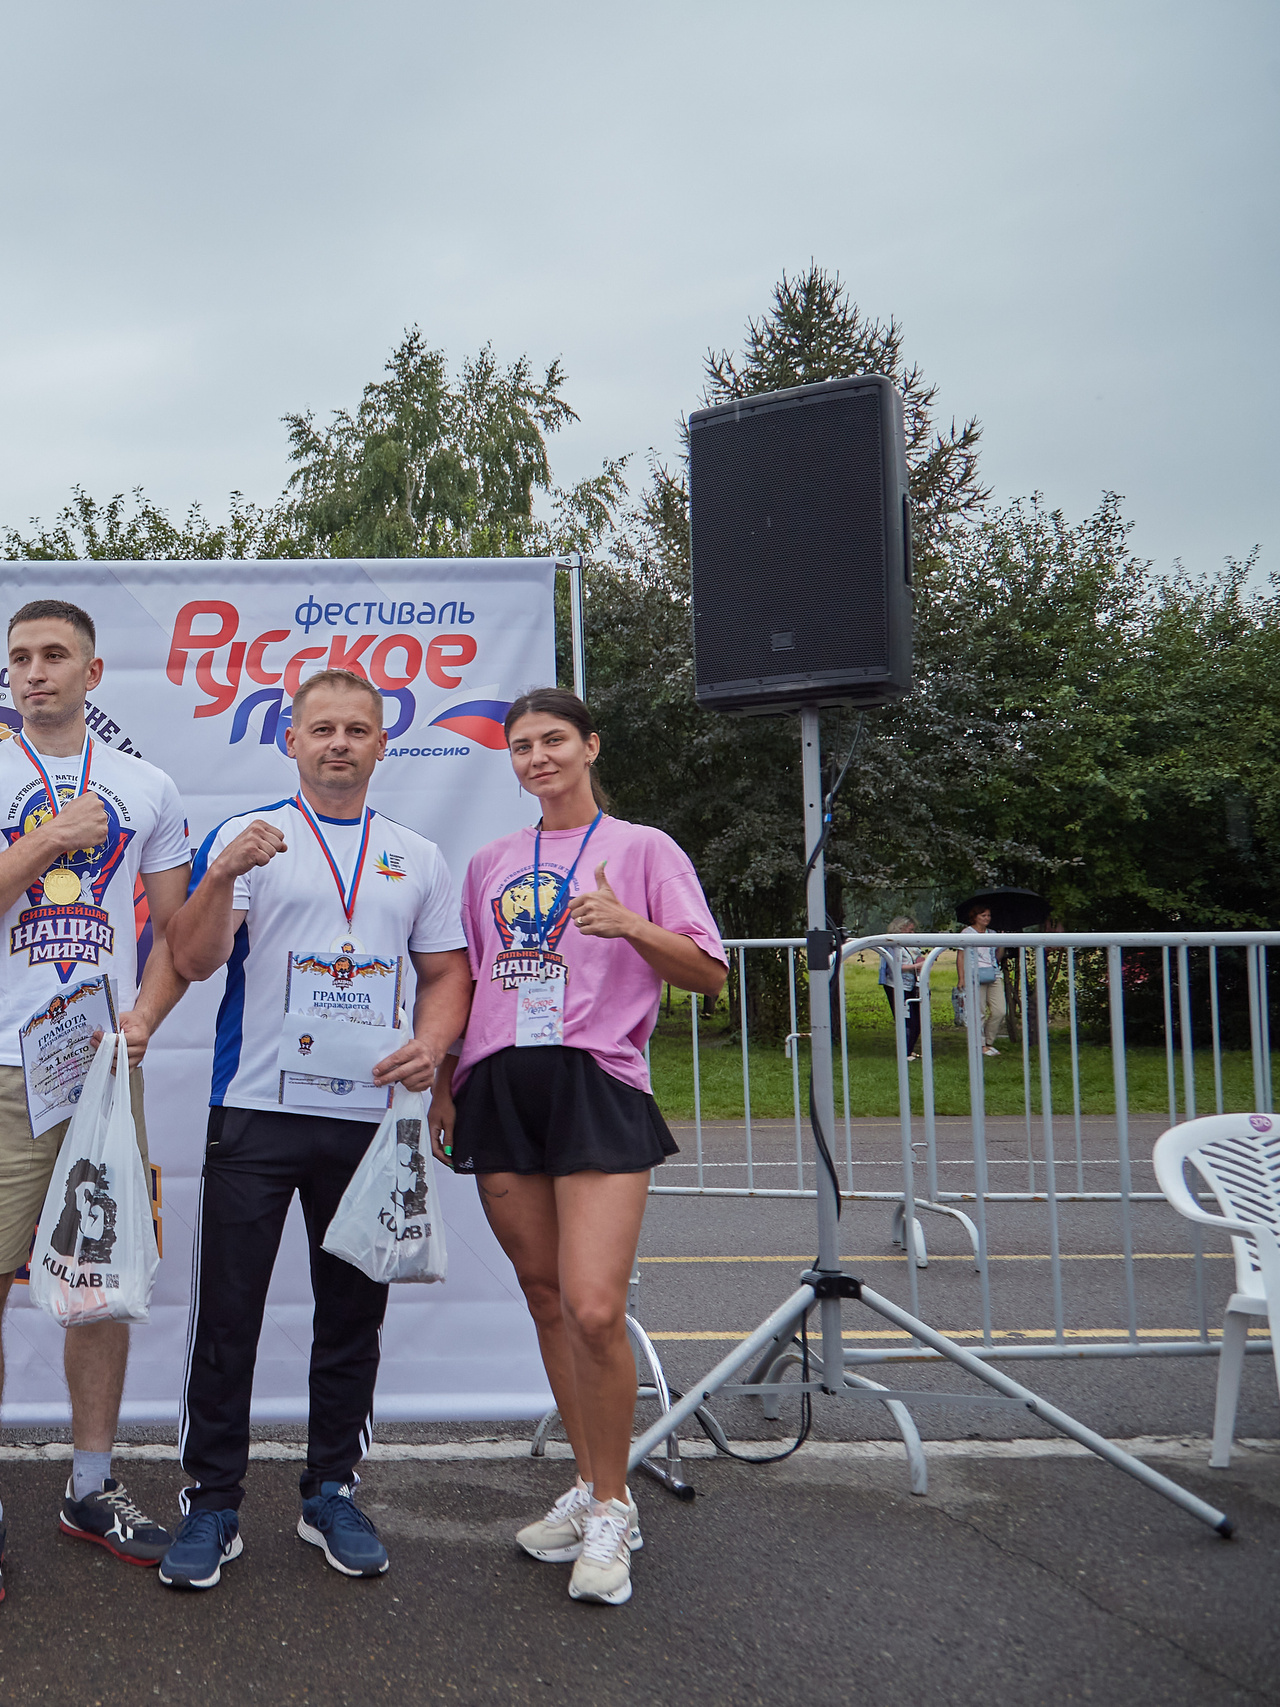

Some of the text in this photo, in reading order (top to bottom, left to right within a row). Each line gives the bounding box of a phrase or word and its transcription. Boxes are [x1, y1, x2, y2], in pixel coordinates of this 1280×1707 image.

[295, 595, 475, 633] фестиваль
[8, 802, 20, 820] THE
[87, 779, 97, 787] IN
[98, 784, 115, 797] THE
[114, 795, 131, 822] WORLD
[22, 905, 107, 922] СИЛЬНЕЙШАЯ
[14, 918, 112, 950] НАЦИЯ
[31, 942, 97, 962] МИРА
[313, 990, 371, 1003] ГРАМОТА
[38, 1014, 87, 1047] ГРАМОТА
[55, 1057, 61, 1066] 1
[63, 1045, 89, 1061] МЕСТО
